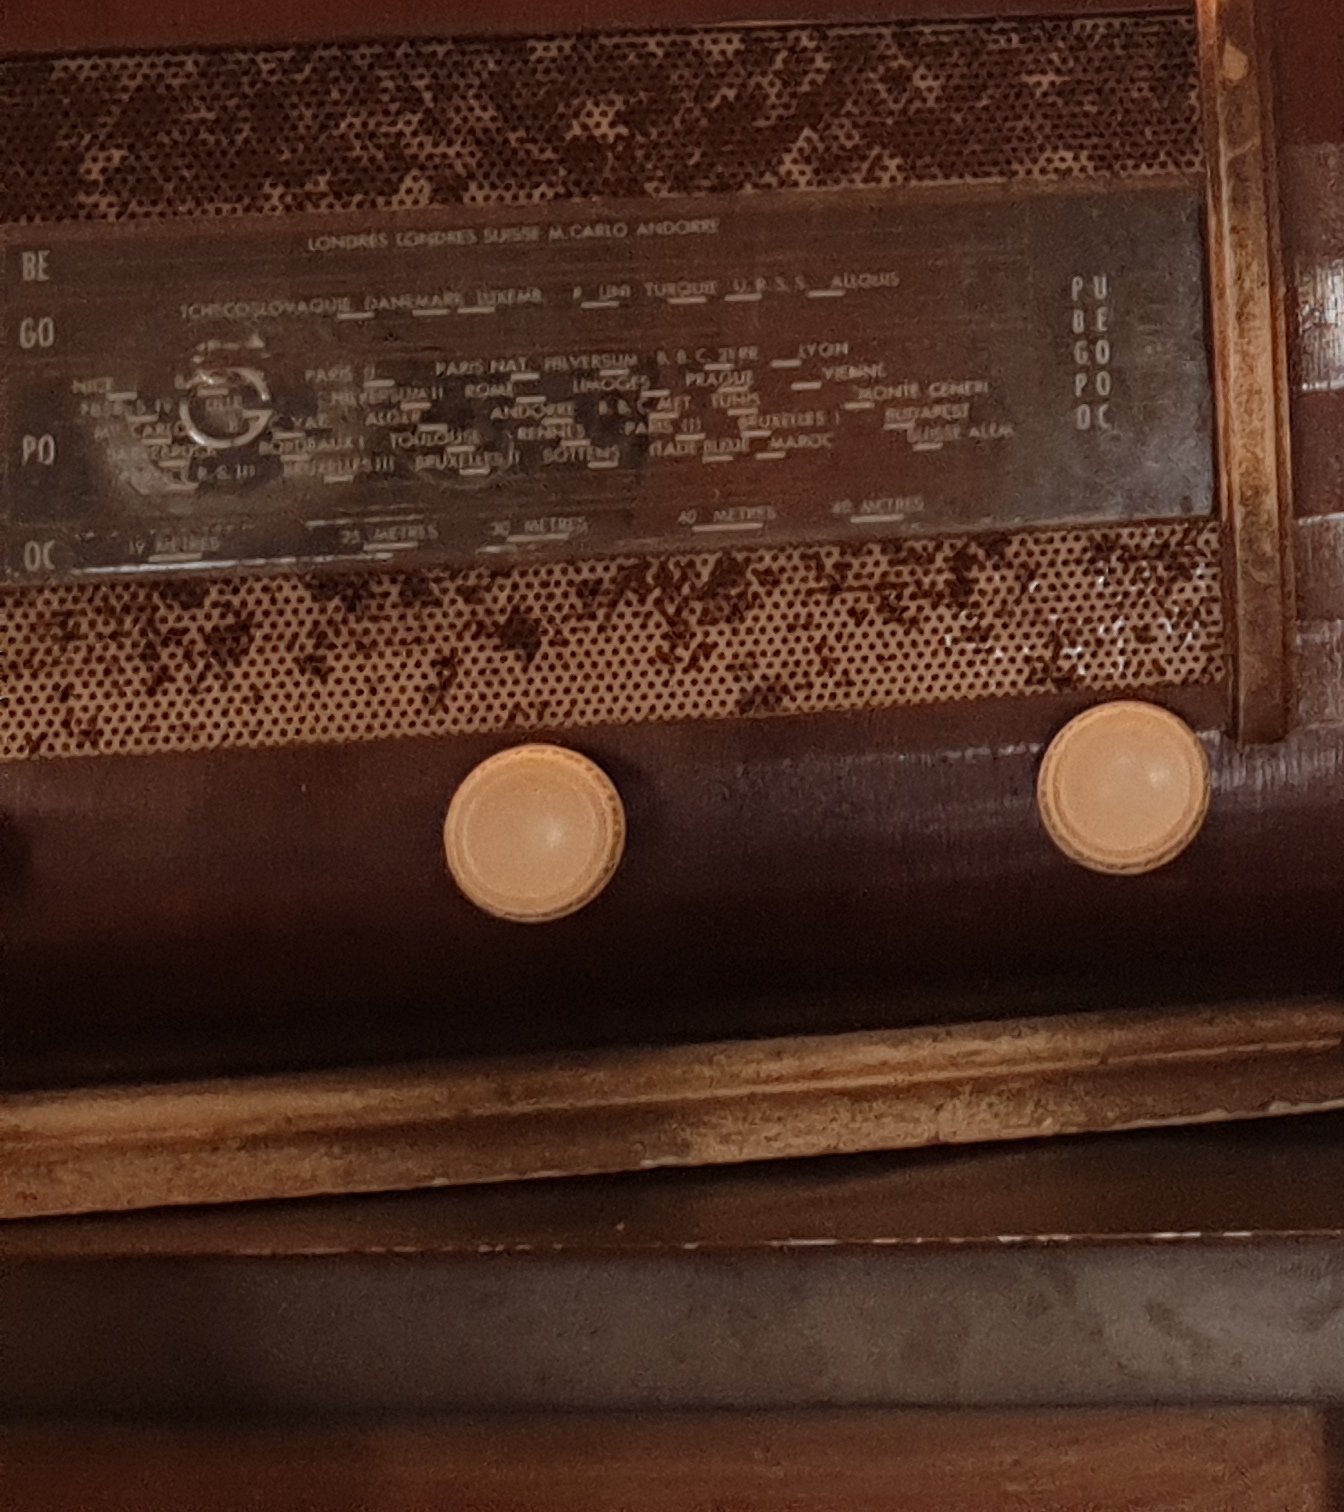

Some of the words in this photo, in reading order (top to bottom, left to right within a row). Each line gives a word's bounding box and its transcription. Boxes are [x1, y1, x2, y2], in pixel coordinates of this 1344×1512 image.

[21, 249, 51, 282] BE
[1071, 273, 1108, 302] PU
[20, 316, 55, 349] GO
[1074, 338, 1111, 366] GO
[1075, 370, 1112, 398] PO
[21, 433, 56, 467] PO
[23, 539, 56, 573] OC
